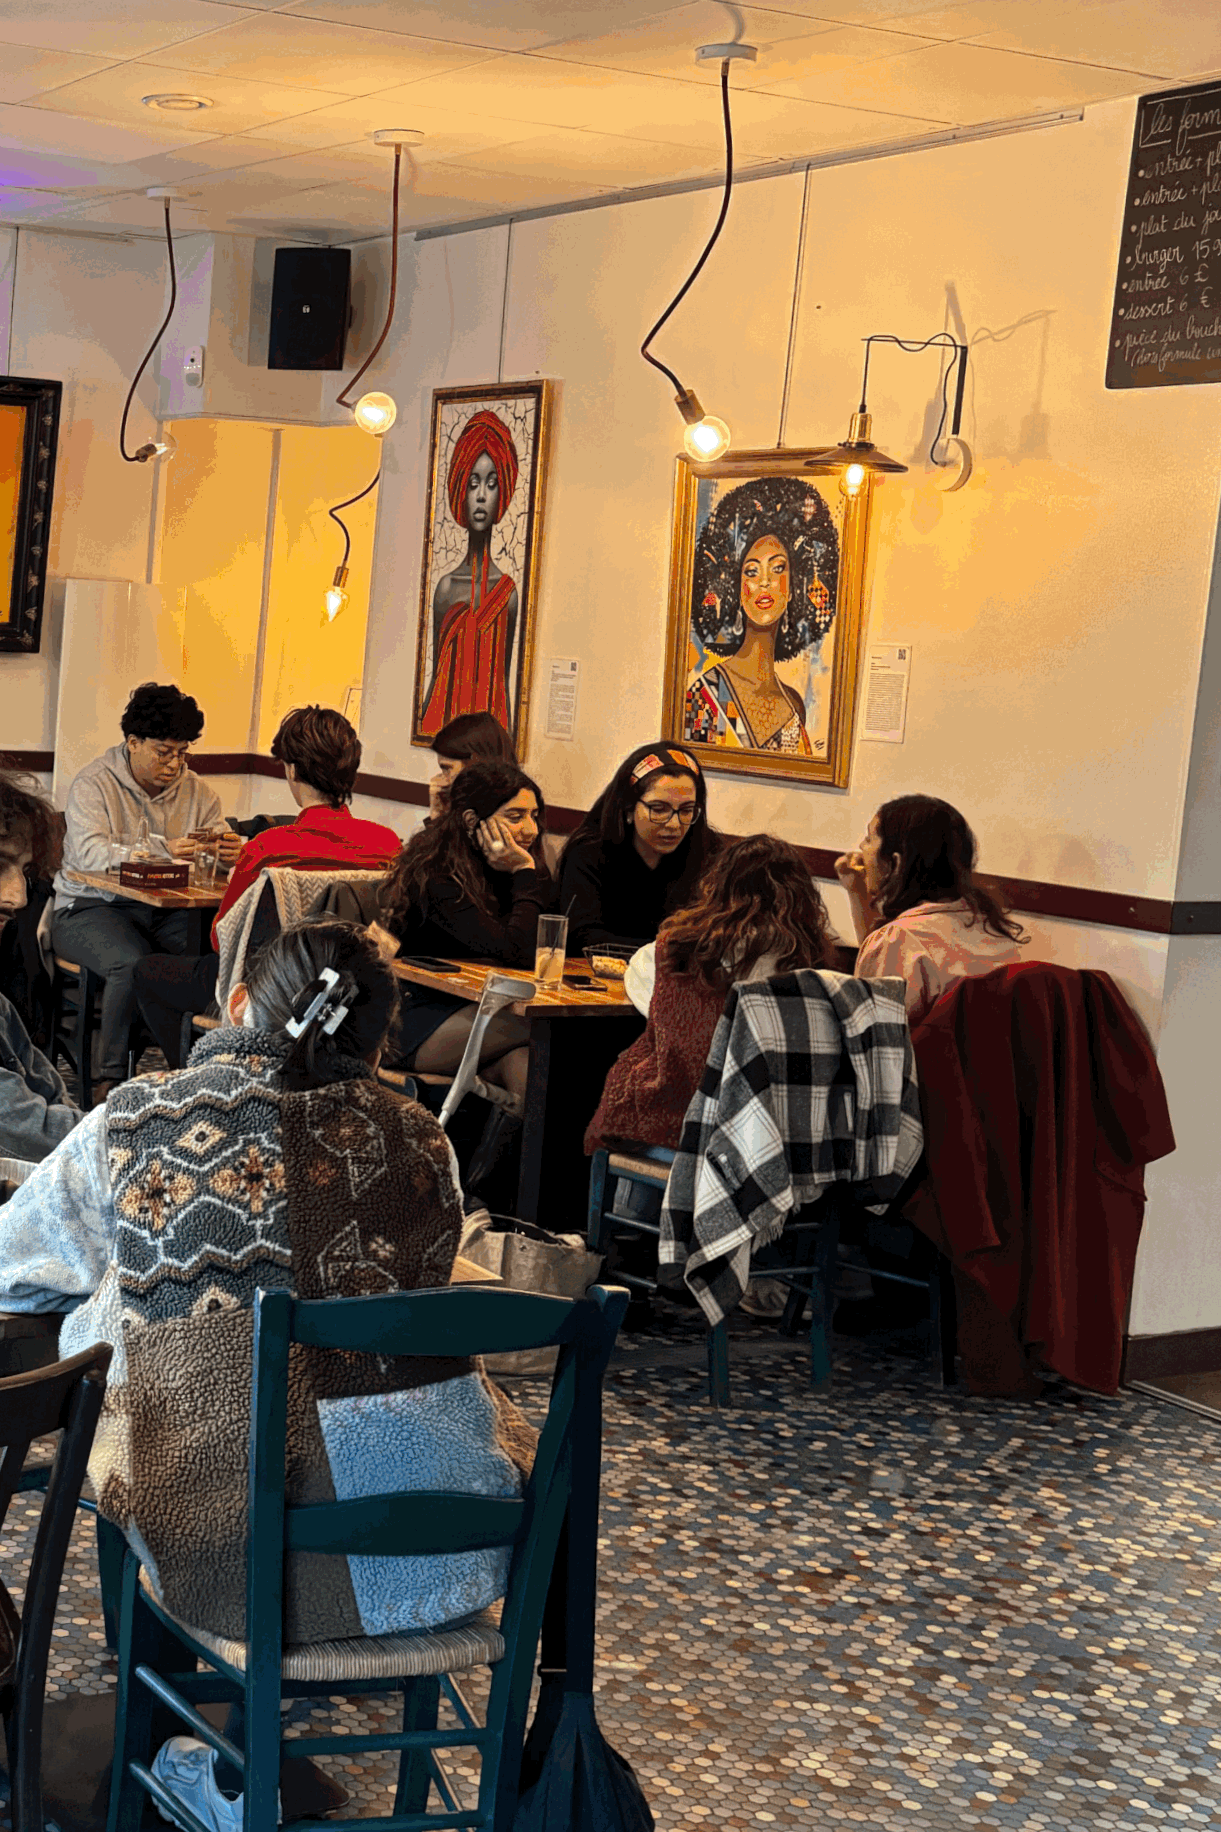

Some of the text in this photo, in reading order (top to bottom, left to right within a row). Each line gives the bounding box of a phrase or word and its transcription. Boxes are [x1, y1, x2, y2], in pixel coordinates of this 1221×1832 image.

[1136, 214, 1169, 250] plat
[1172, 211, 1196, 230] du
[1128, 245, 1185, 274] burger
[1179, 265, 1189, 285] 6
[1123, 296, 1176, 320] dessert
[1179, 293, 1188, 312] 6
[1160, 325, 1181, 343] du
